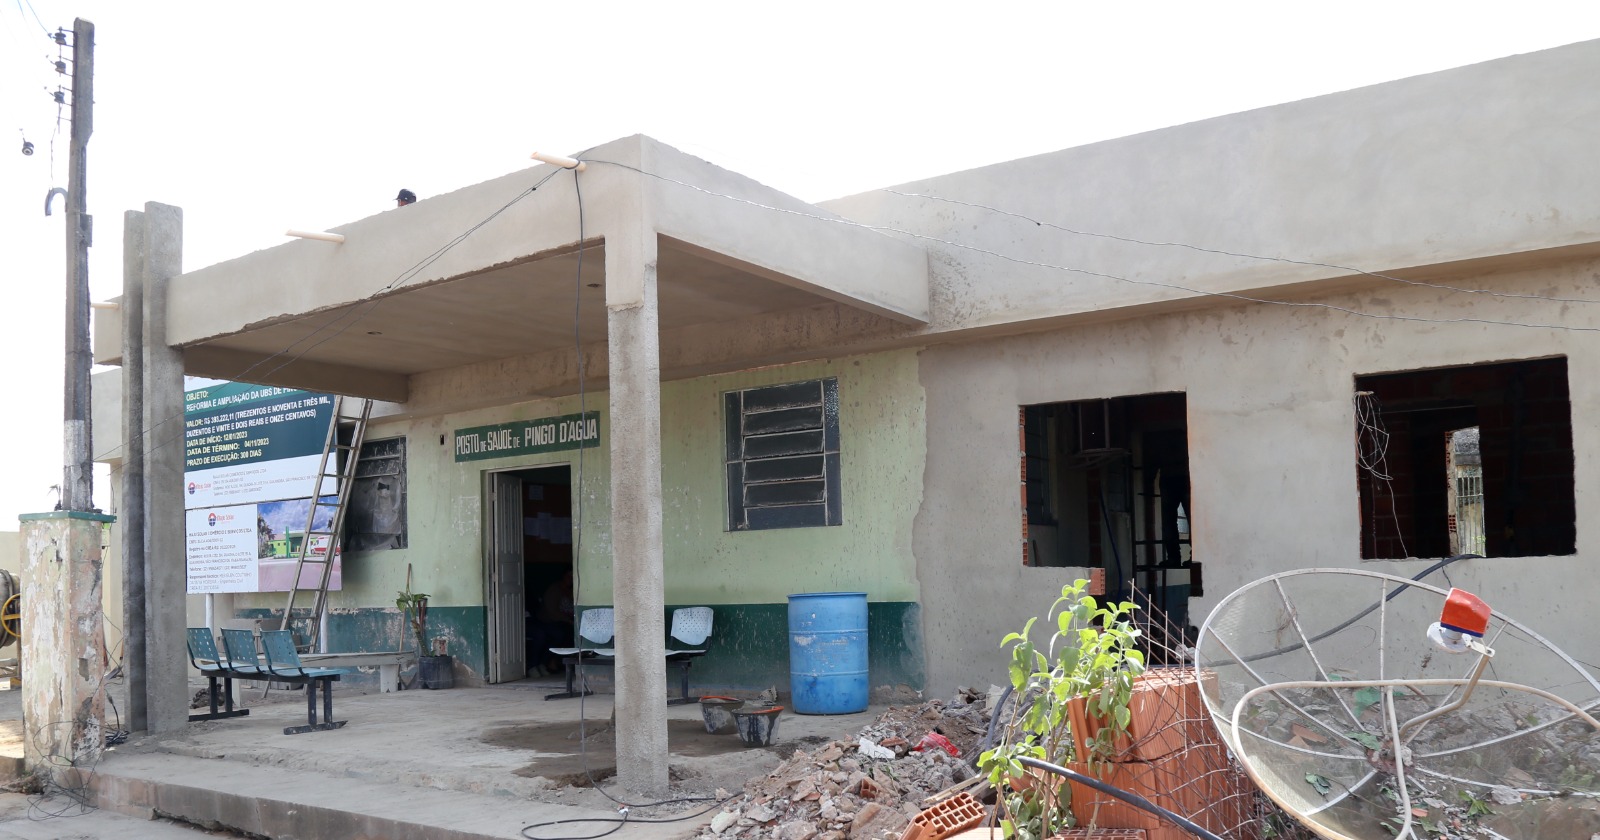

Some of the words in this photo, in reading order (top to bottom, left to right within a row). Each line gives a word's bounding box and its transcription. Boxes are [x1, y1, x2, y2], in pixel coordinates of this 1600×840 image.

[186, 390, 208, 401] OBJETO:
[187, 402, 212, 412] REFORMA
[218, 392, 250, 405] AMPLIAÇÃO
[260, 388, 272, 397] UBS
[186, 419, 203, 428] VALOR:
[235, 407, 266, 420] (TREZENTOS
[272, 402, 297, 412] NOVENTA
[304, 397, 318, 407] TRÊS
[319, 396, 330, 404] MIL,
[187, 427, 211, 437] DUZENTOS
[216, 424, 230, 432] VINTE
[249, 418, 264, 427] REAIS
[270, 414, 284, 424] ONZE
[285, 409, 316, 421] CENTAVOS)
[187, 439, 198, 447] DATA
[207, 435, 222, 444] INÍCIO:
[456, 434, 479, 455] POSTO
[480, 441, 487, 452] DE
[488, 429, 512, 451] SAÚDE
[513, 436, 520, 448] DE
[525, 424, 555, 447] PINGO
[187, 447, 202, 456] DATA
[212, 443, 240, 453] TÉRMINO:
[211, 452, 239, 463] EXECUÇÃO:
[250, 449, 262, 457] DIAS
